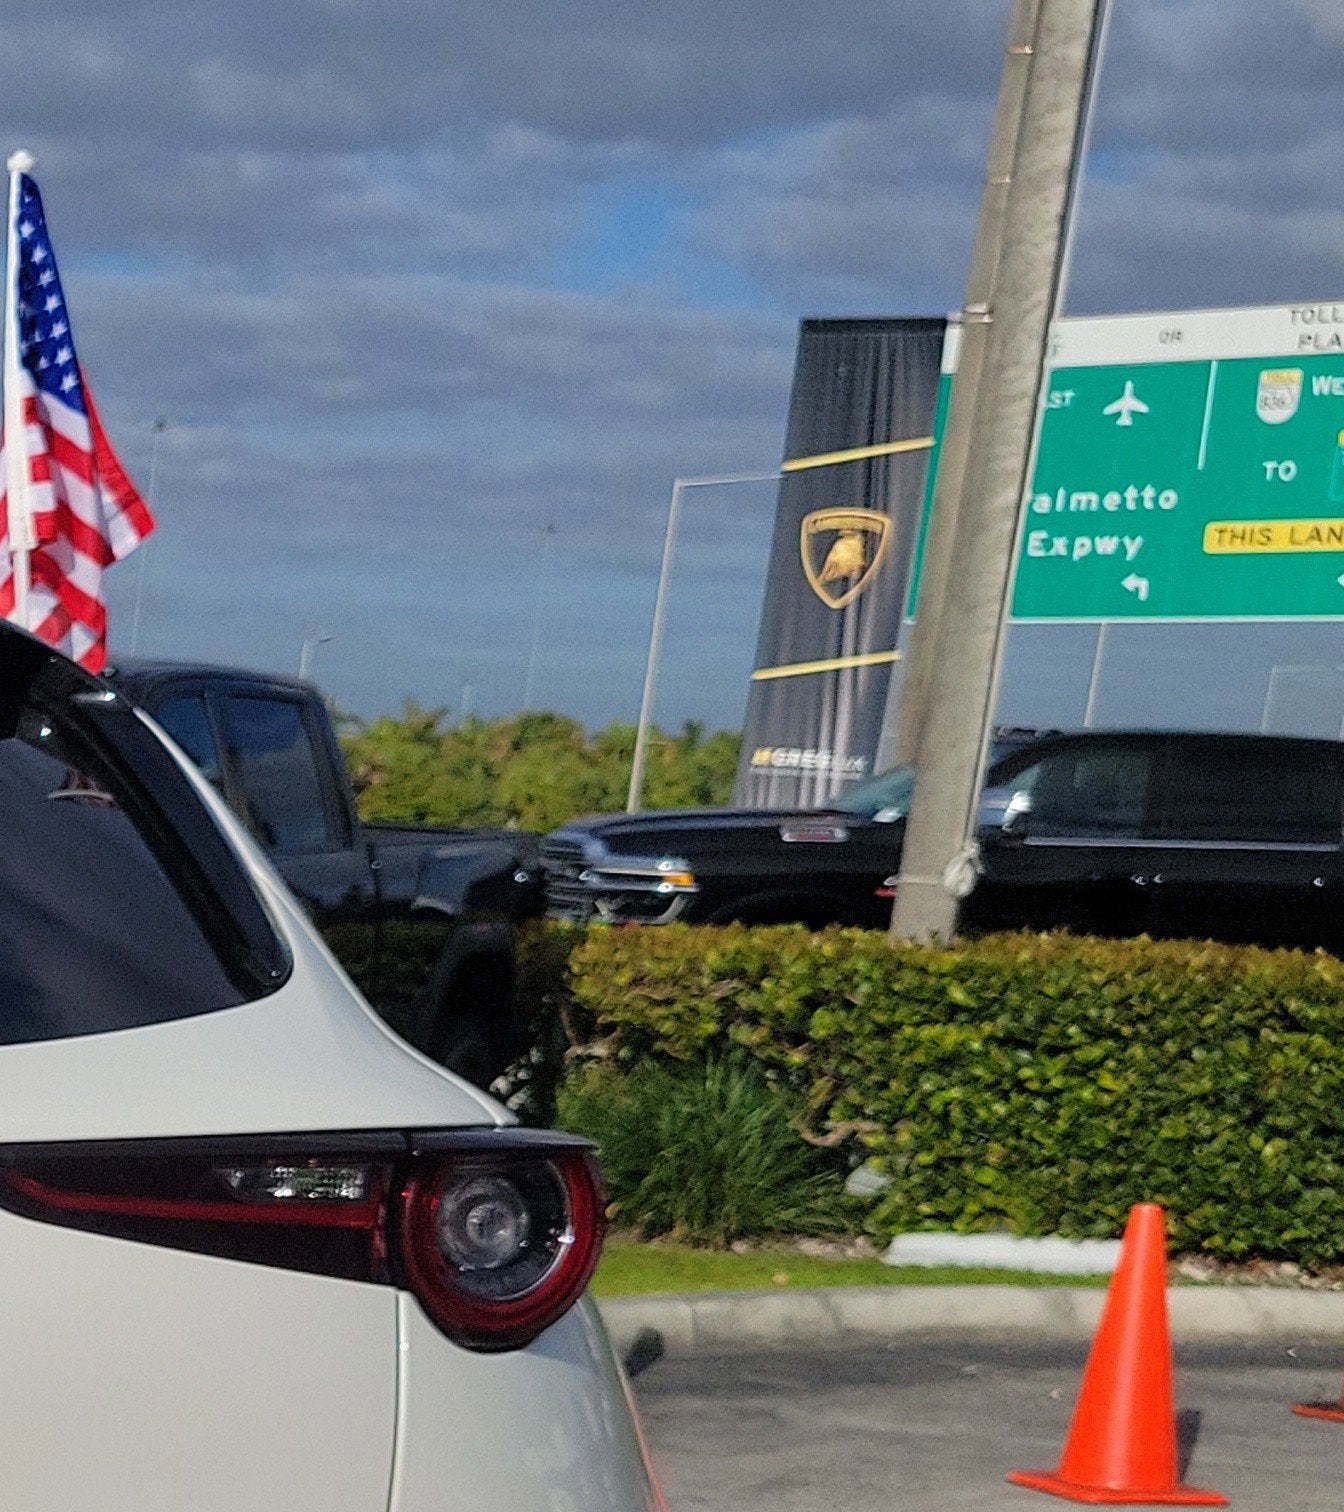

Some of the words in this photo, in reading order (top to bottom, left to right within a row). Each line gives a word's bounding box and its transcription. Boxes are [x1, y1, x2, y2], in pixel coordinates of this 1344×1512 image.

[1262, 460, 1298, 482] TO
[1031, 484, 1179, 514] almetto
[1026, 529, 1145, 561] Expwy
[1214, 526, 1272, 547] THIS
